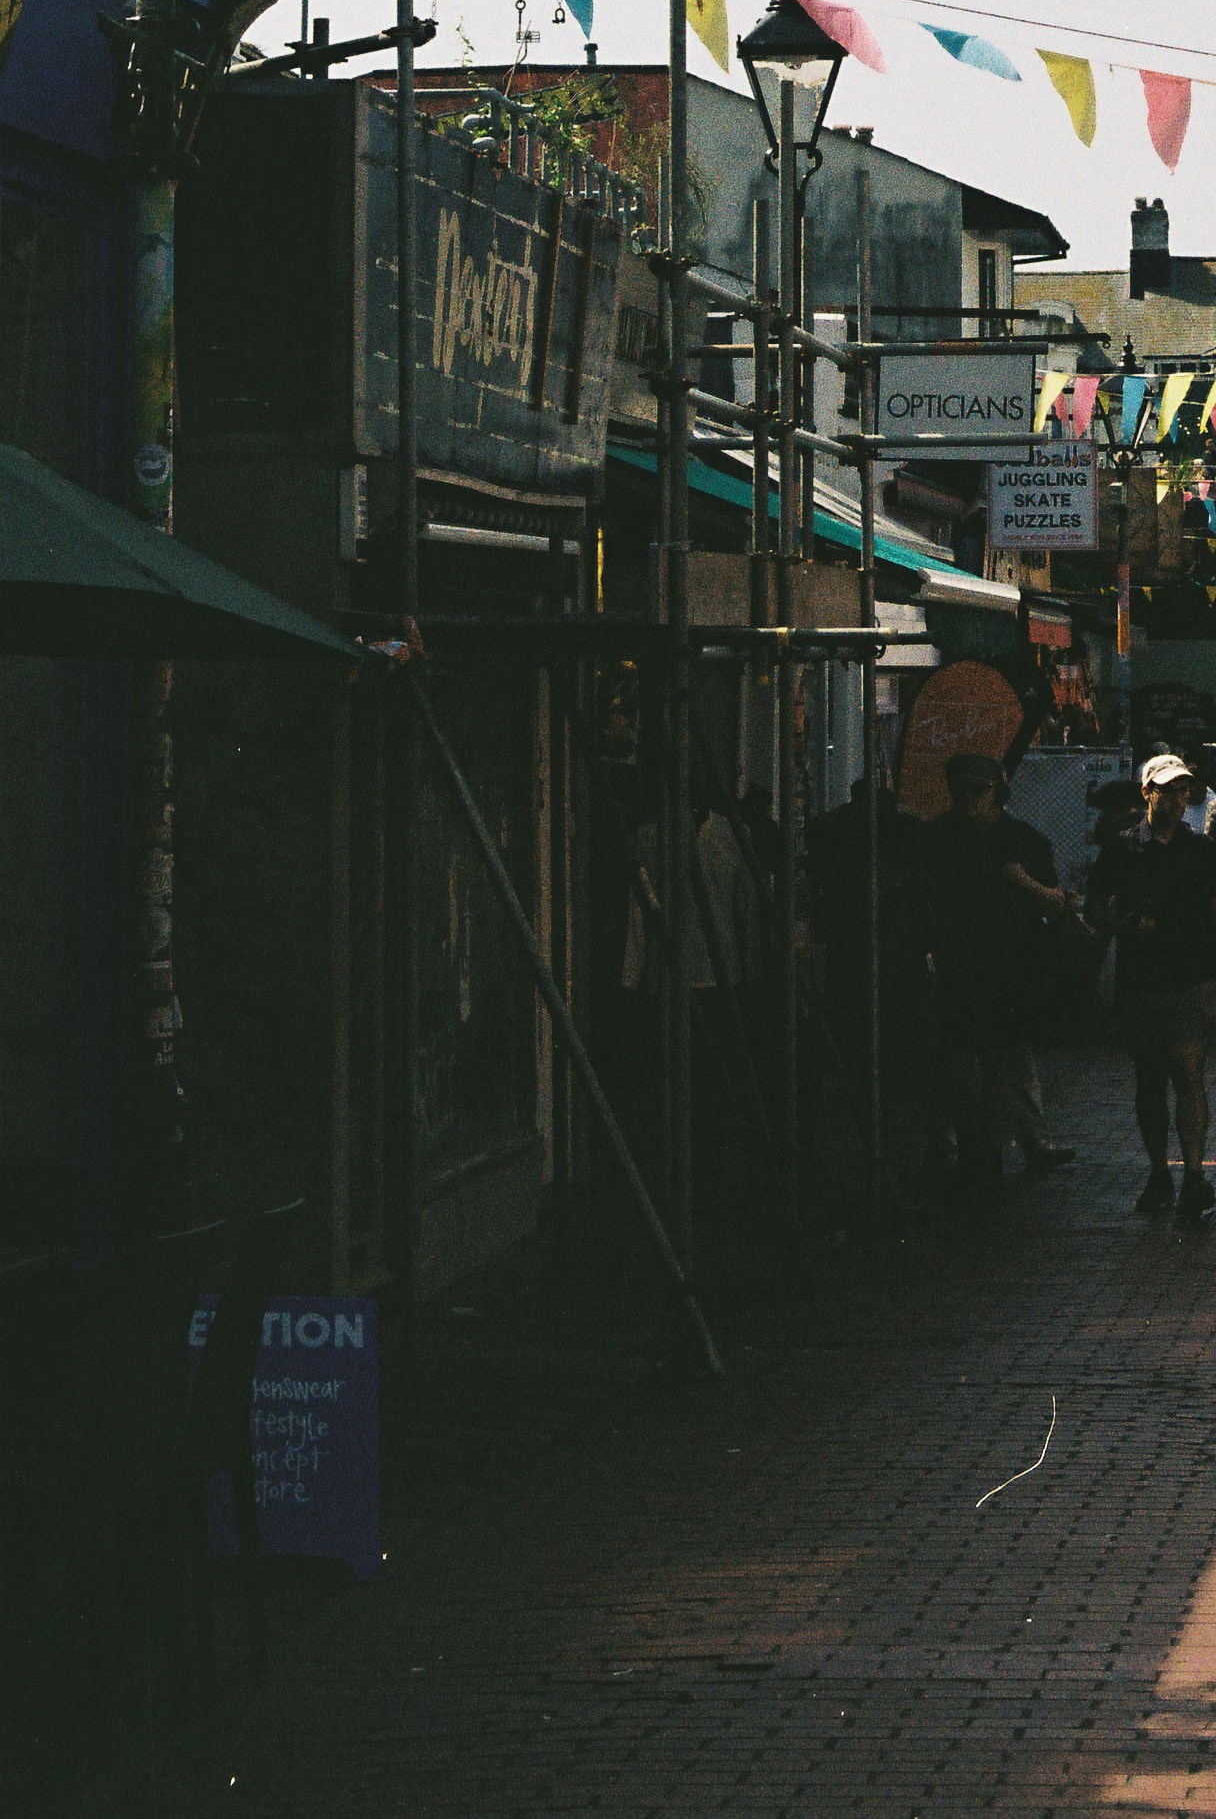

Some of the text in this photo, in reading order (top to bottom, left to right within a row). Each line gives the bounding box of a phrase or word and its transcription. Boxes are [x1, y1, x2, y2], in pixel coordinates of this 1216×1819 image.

[886, 393, 1024, 421] OPTICIANS
[993, 445, 1092, 469] balls
[997, 472, 1087, 487] JUGGLING
[1013, 493, 1072, 508] SKATE
[1003, 513, 1082, 528] PUZZLES
[188, 1310, 364, 1348] ETION
[253, 1378, 345, 1402] enswear
[256, 1409, 328, 1451] festyle
